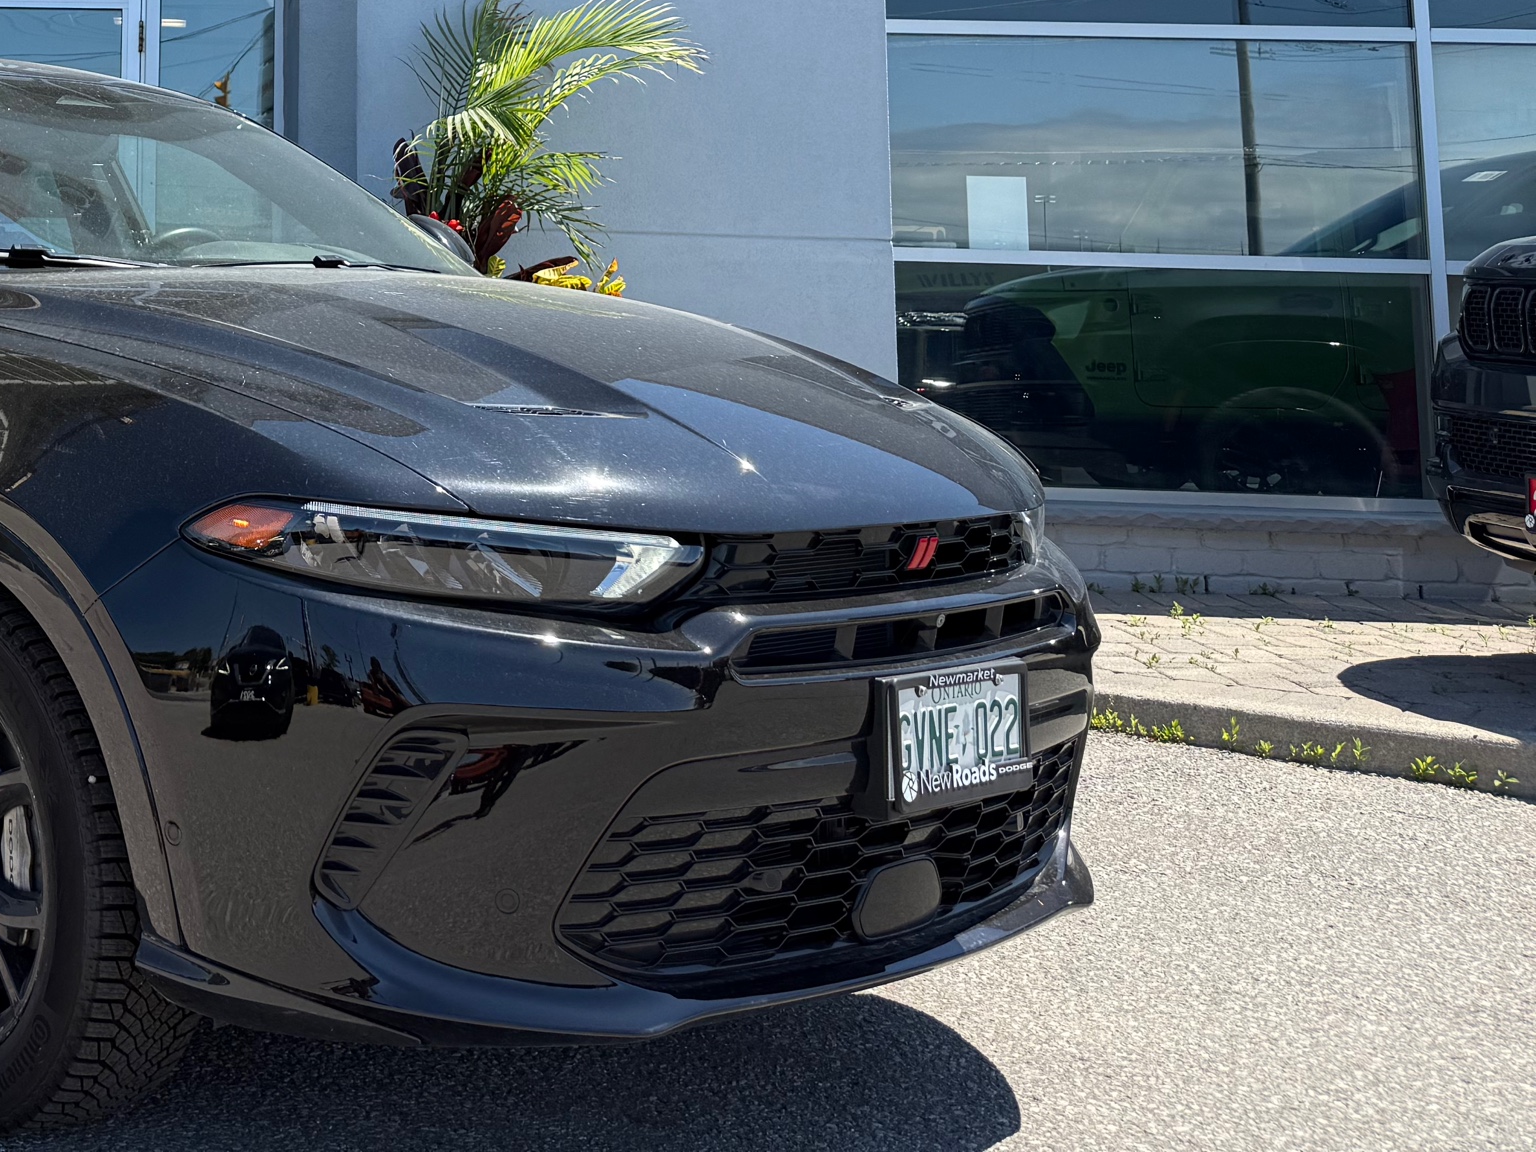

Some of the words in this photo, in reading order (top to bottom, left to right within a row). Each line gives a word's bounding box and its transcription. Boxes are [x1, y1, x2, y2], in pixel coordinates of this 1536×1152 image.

[1084, 359, 1127, 374] Jeep
[929, 668, 996, 687] Newmarket
[931, 682, 982, 704] ONTARIO
[900, 704, 959, 771] GVNE
[975, 697, 1020, 761] 022
[920, 758, 998, 795] NewRoads
